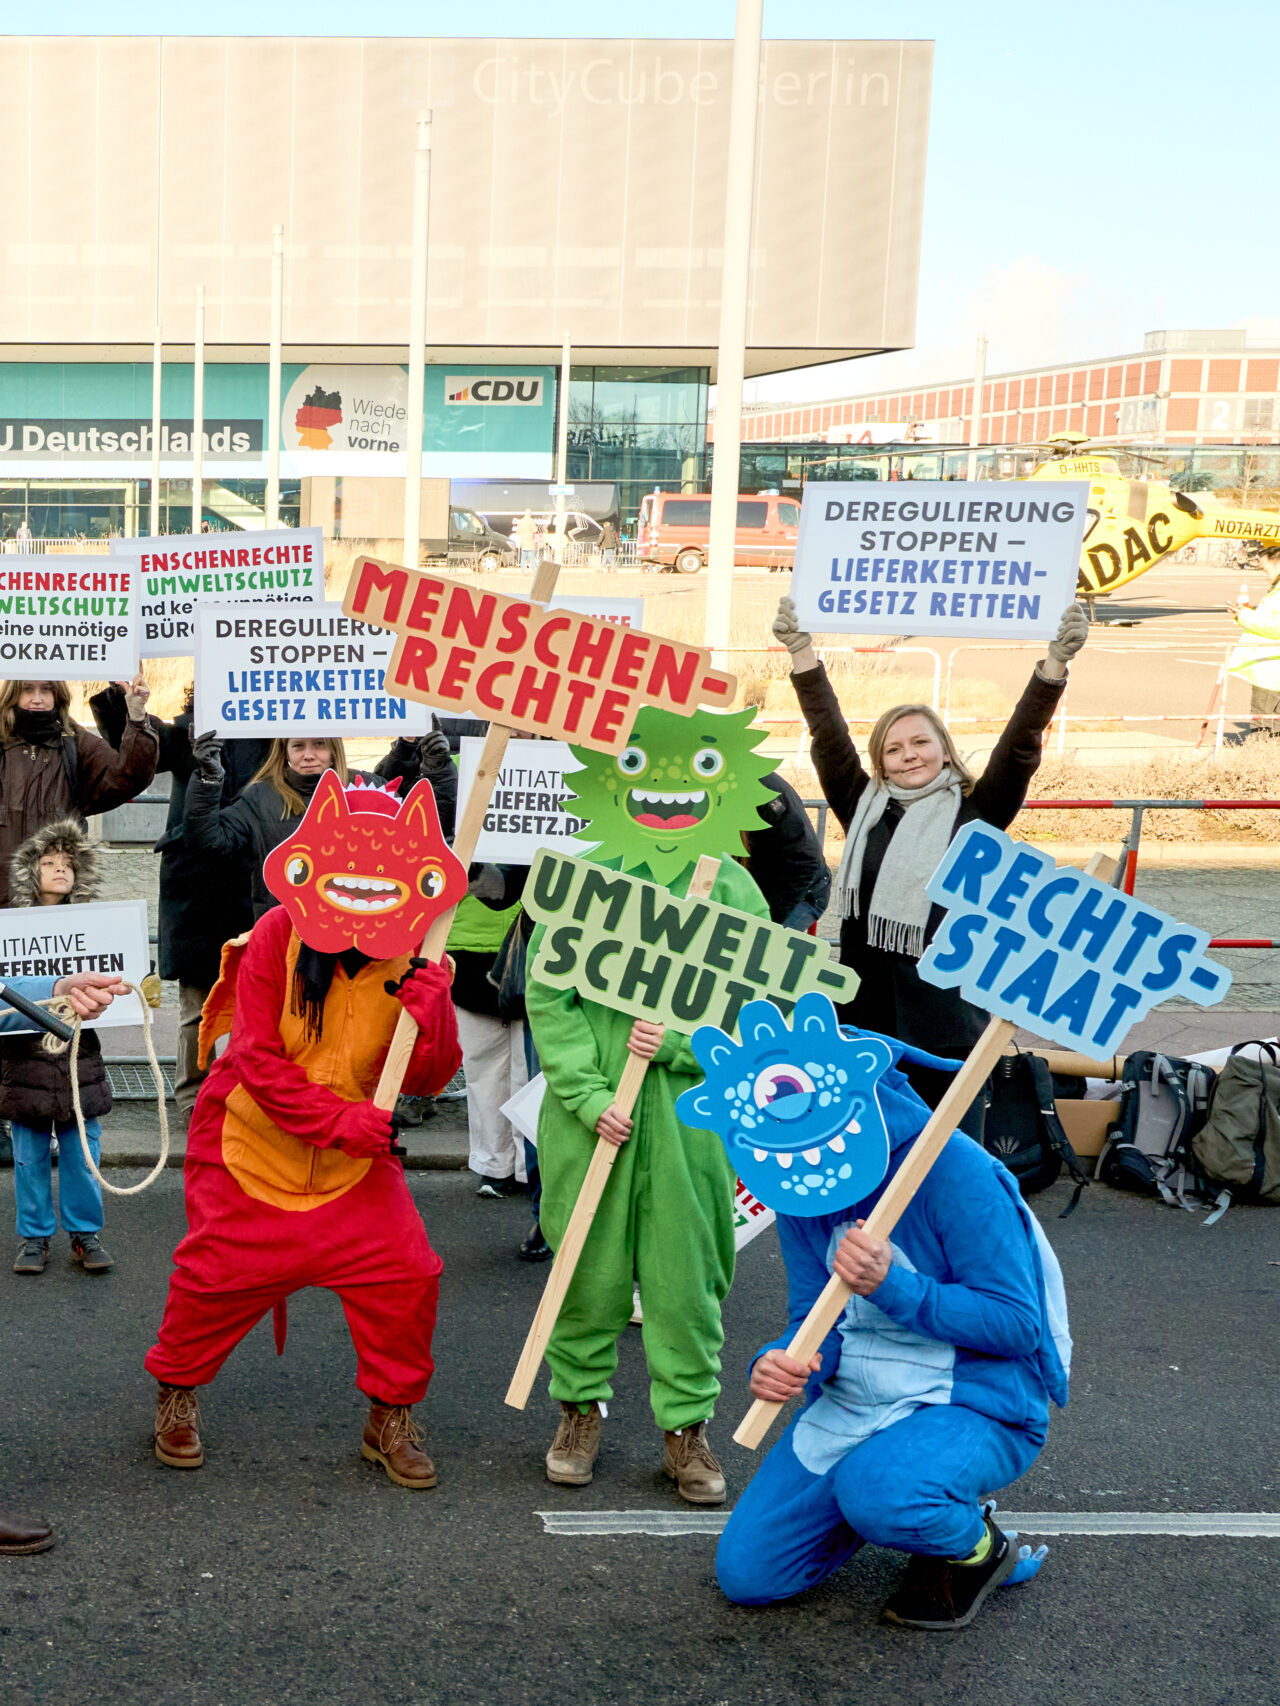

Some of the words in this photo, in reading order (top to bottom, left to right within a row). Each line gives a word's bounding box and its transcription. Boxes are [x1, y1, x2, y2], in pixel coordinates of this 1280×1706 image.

[472, 55, 718, 117] CityCube
[759, 56, 891, 107] erlin
[470, 380, 539, 403] CDU
[352, 397, 408, 420] Wiede
[1210, 400, 1231, 430] 2
[22, 424, 251, 454] Deutschlands
[349, 419, 391, 436] nach
[347, 435, 400, 453] vorne
[1059, 461, 1100, 474] D-HHTS
[824, 500, 1074, 523] DEREGULIERUNG
[1214, 519, 1280, 538] NOTARZT
[859, 530, 998, 553] STOPPEN
[140, 544, 313, 573] ENSCHENRECHTE
[146, 567, 313, 596] UMWELTSCHUTZ
[830, 557, 1047, 586] LIEFERKETTEN-
[141, 600, 166, 617] nd
[817, 589, 918, 616] GESETZ
[929, 591, 1041, 620] RETTEN
[39, 621, 129, 642] unnötige
[215, 618, 391, 639] DEREGULIERU
[351, 561, 729, 705] MENSCHEN-
[250, 644, 365, 664] STOPPEN
[394, 635, 631, 744] RECHTE
[221, 698, 306, 721] GESETZ
[317, 697, 407, 720] RETTEN
[497, 768, 565, 790] NITIATI
[487, 790, 578, 813] IEFERK
[942, 830, 1220, 992] RECHTS-
[533, 855, 846, 993] UMWELT-
[932, 913, 1143, 1047] STAAT
